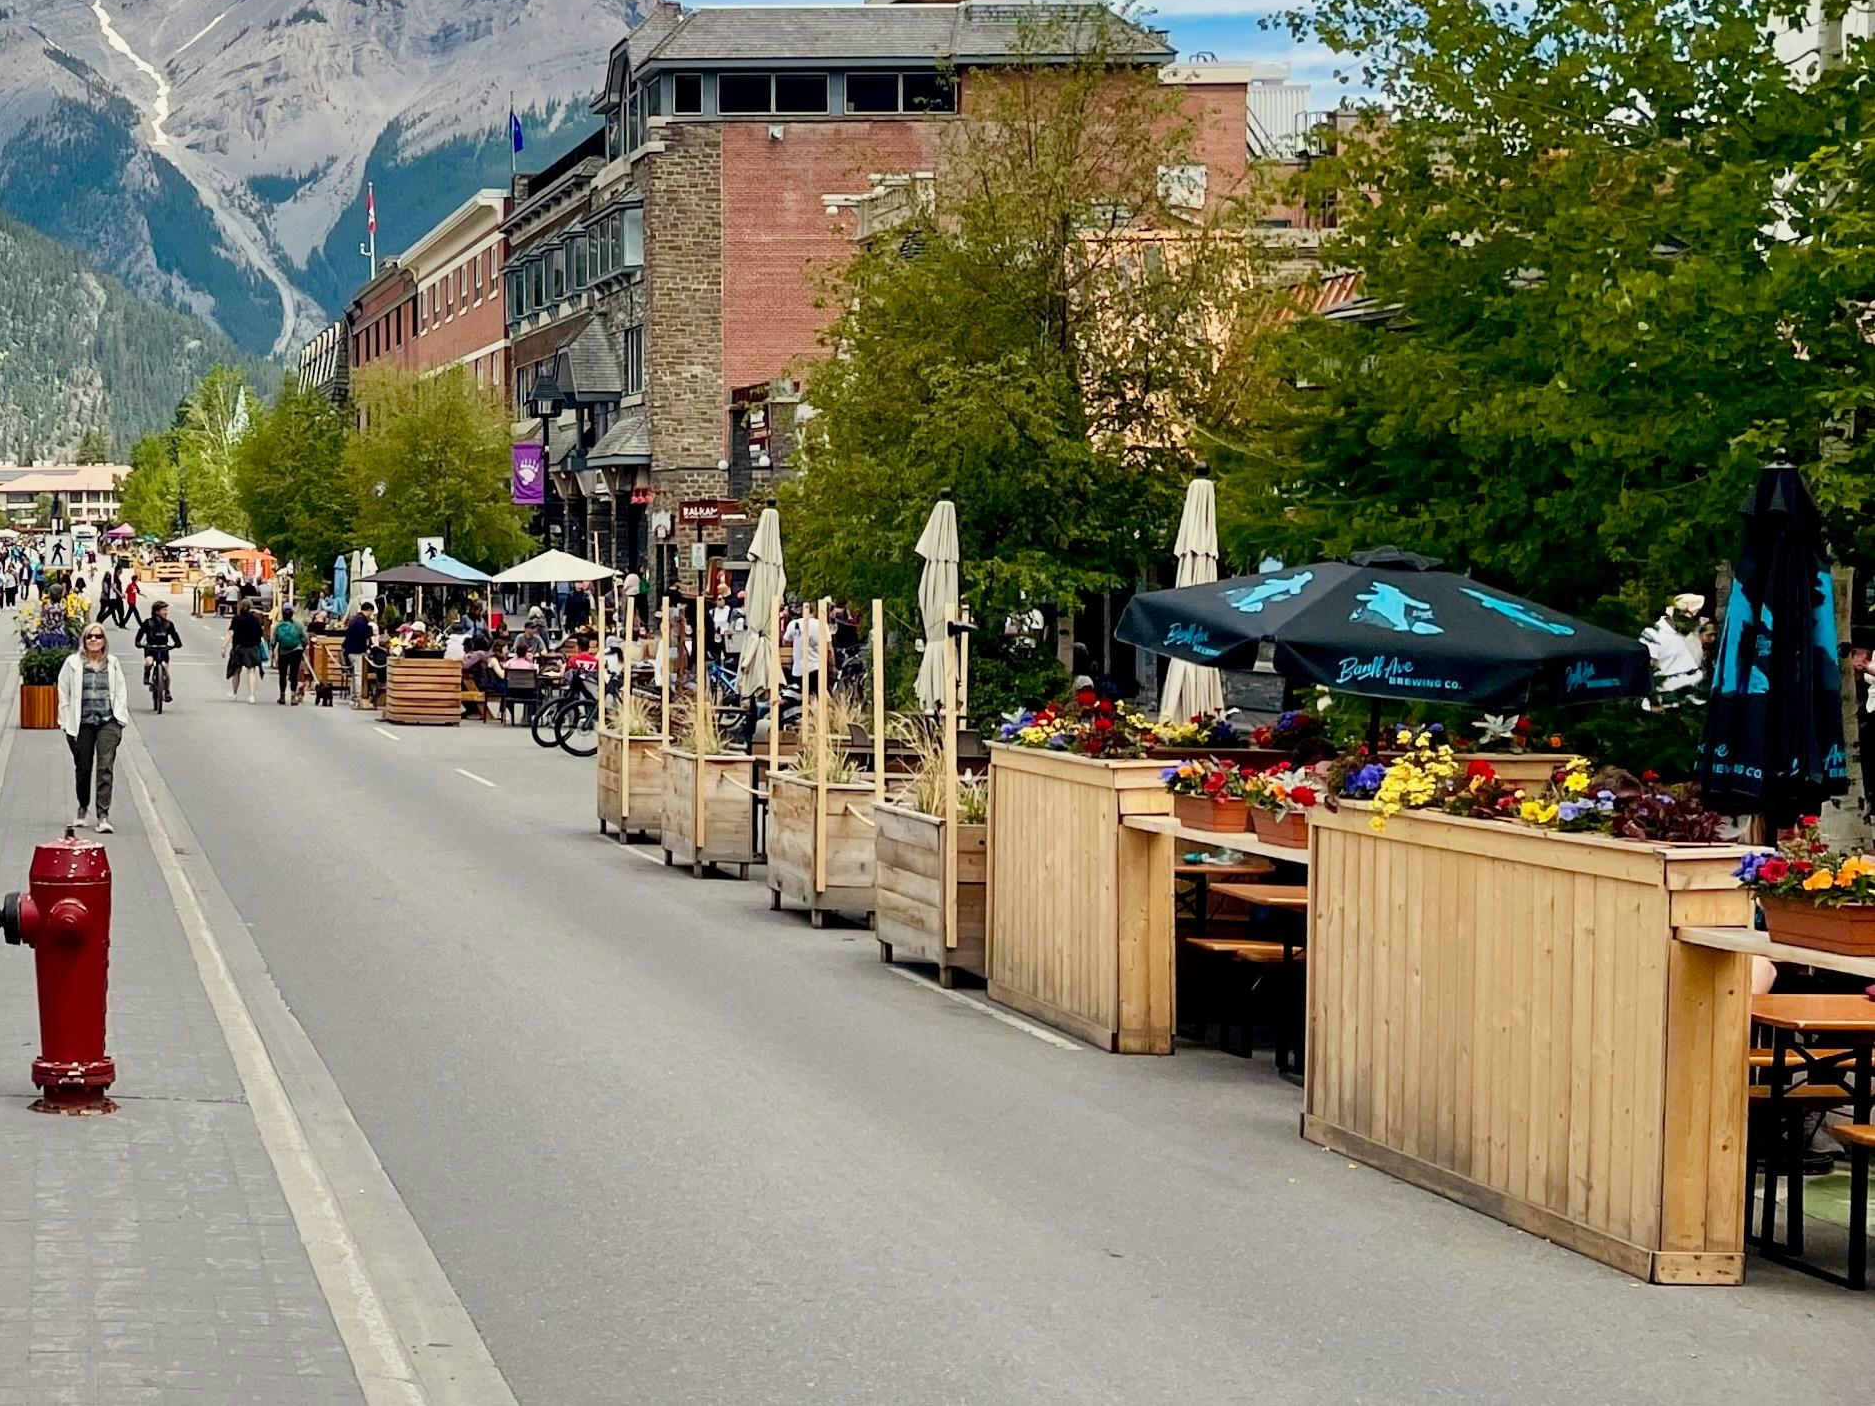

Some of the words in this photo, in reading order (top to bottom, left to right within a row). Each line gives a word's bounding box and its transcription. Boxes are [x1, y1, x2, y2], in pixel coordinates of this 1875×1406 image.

[1336, 655, 1385, 684] Banff
[1384, 656, 1414, 678] Ave
[1388, 676, 1442, 688] BREWING
